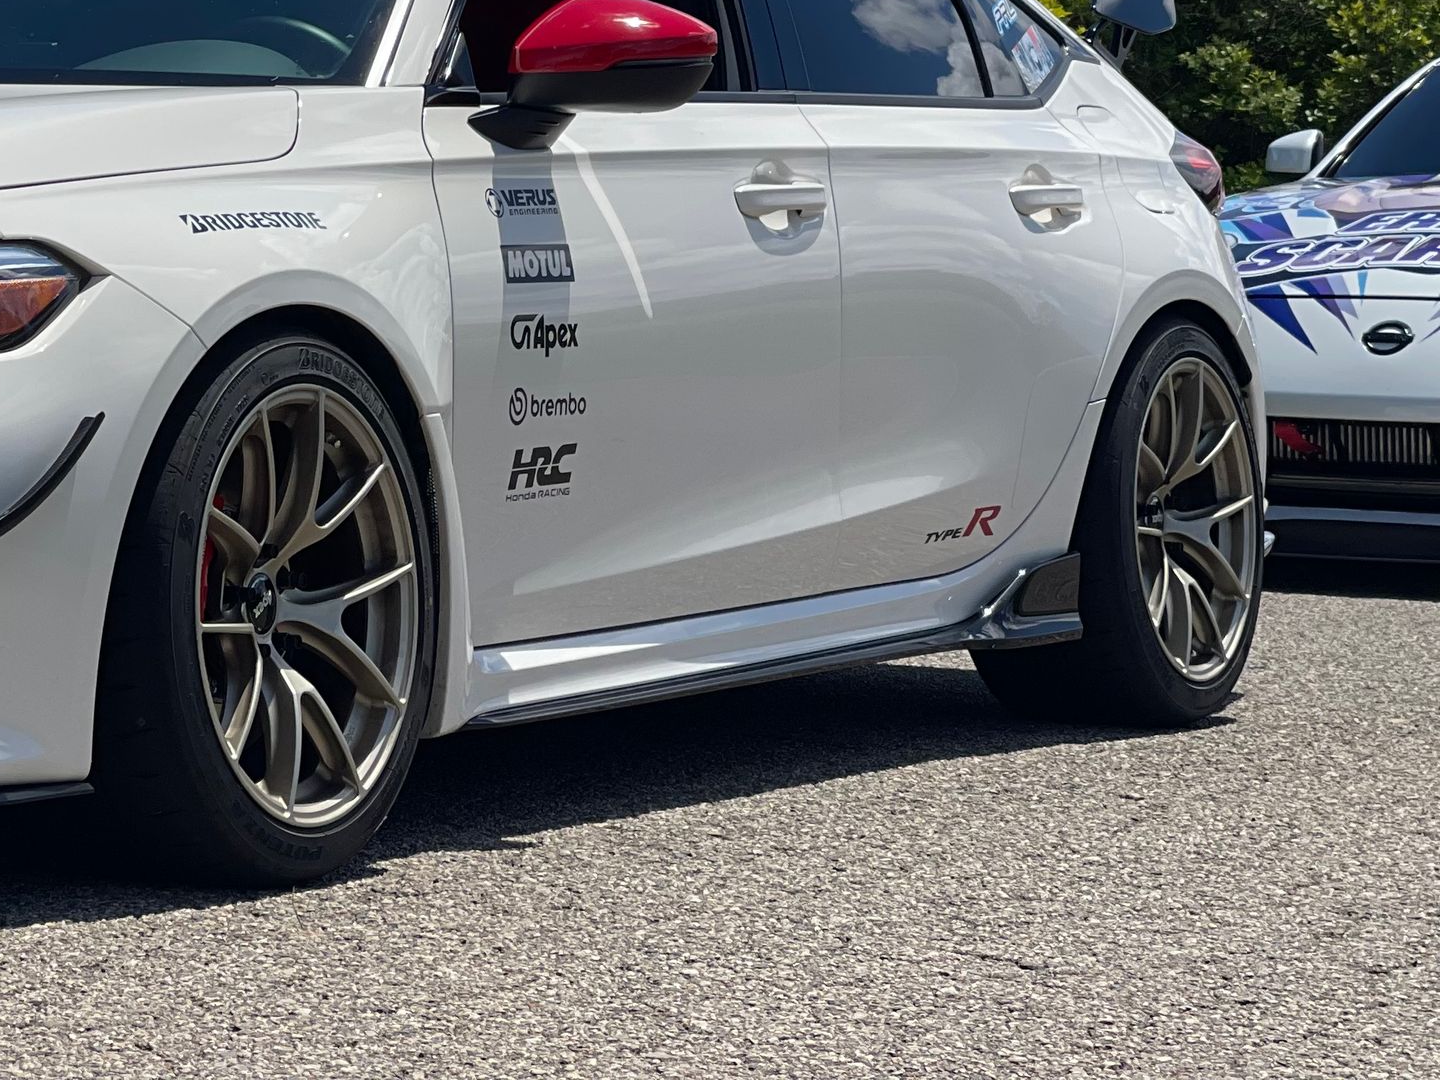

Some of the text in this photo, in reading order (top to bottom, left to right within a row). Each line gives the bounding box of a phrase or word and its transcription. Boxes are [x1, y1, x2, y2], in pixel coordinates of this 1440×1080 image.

[500, 188, 557, 207] VERUS
[178, 211, 328, 234] BRIDGESTONE
[507, 249, 572, 279] MOTUL
[530, 392, 587, 418] brembo
[507, 442, 578, 491] HRC
[537, 486, 571, 499] RACING
[924, 505, 1002, 545] TYPE R
